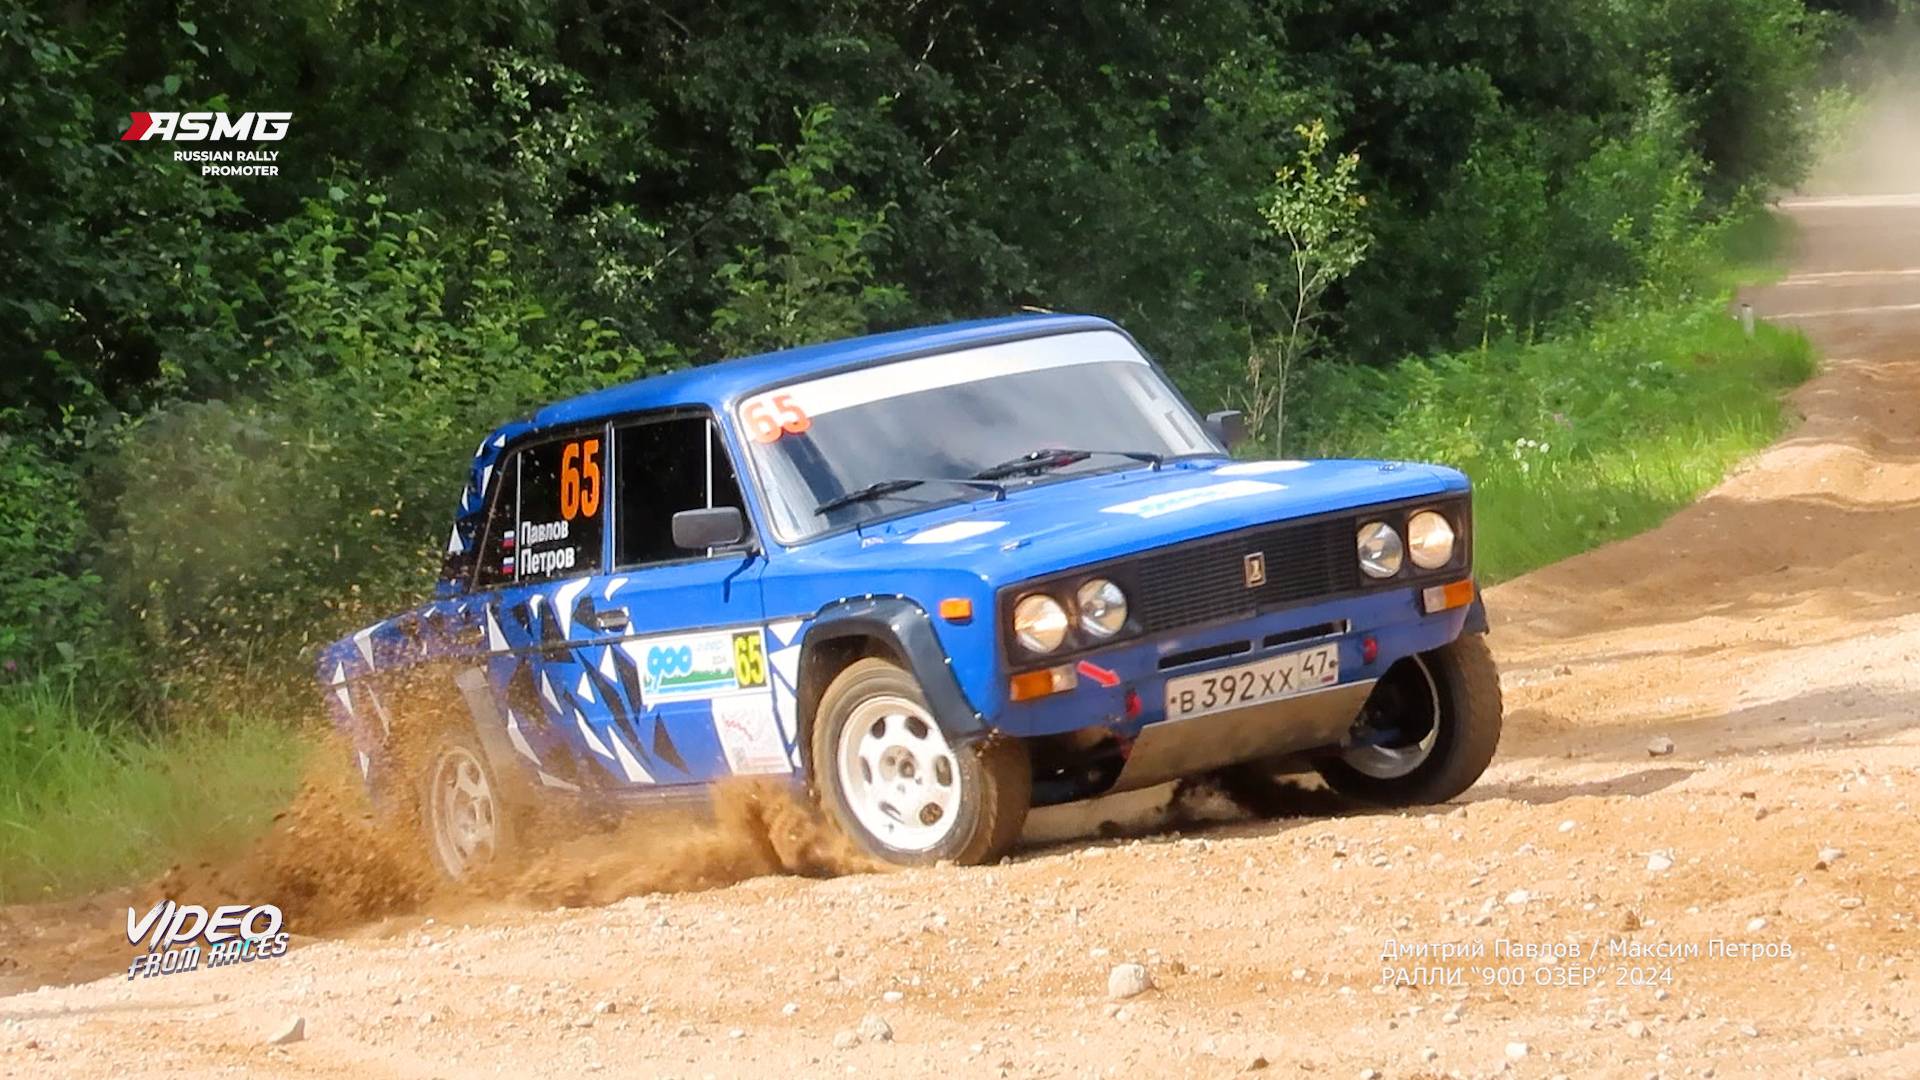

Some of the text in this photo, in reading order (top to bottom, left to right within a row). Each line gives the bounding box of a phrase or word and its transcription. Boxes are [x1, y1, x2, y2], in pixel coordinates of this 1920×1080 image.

[743, 395, 812, 444] 65
[560, 439, 600, 520] 65
[520, 519, 570, 546] Павлов
[520, 546, 576, 577] Петров
[647, 645, 693, 692] 900
[734, 634, 766, 686] 65
[1302, 651, 1328, 677] 47
